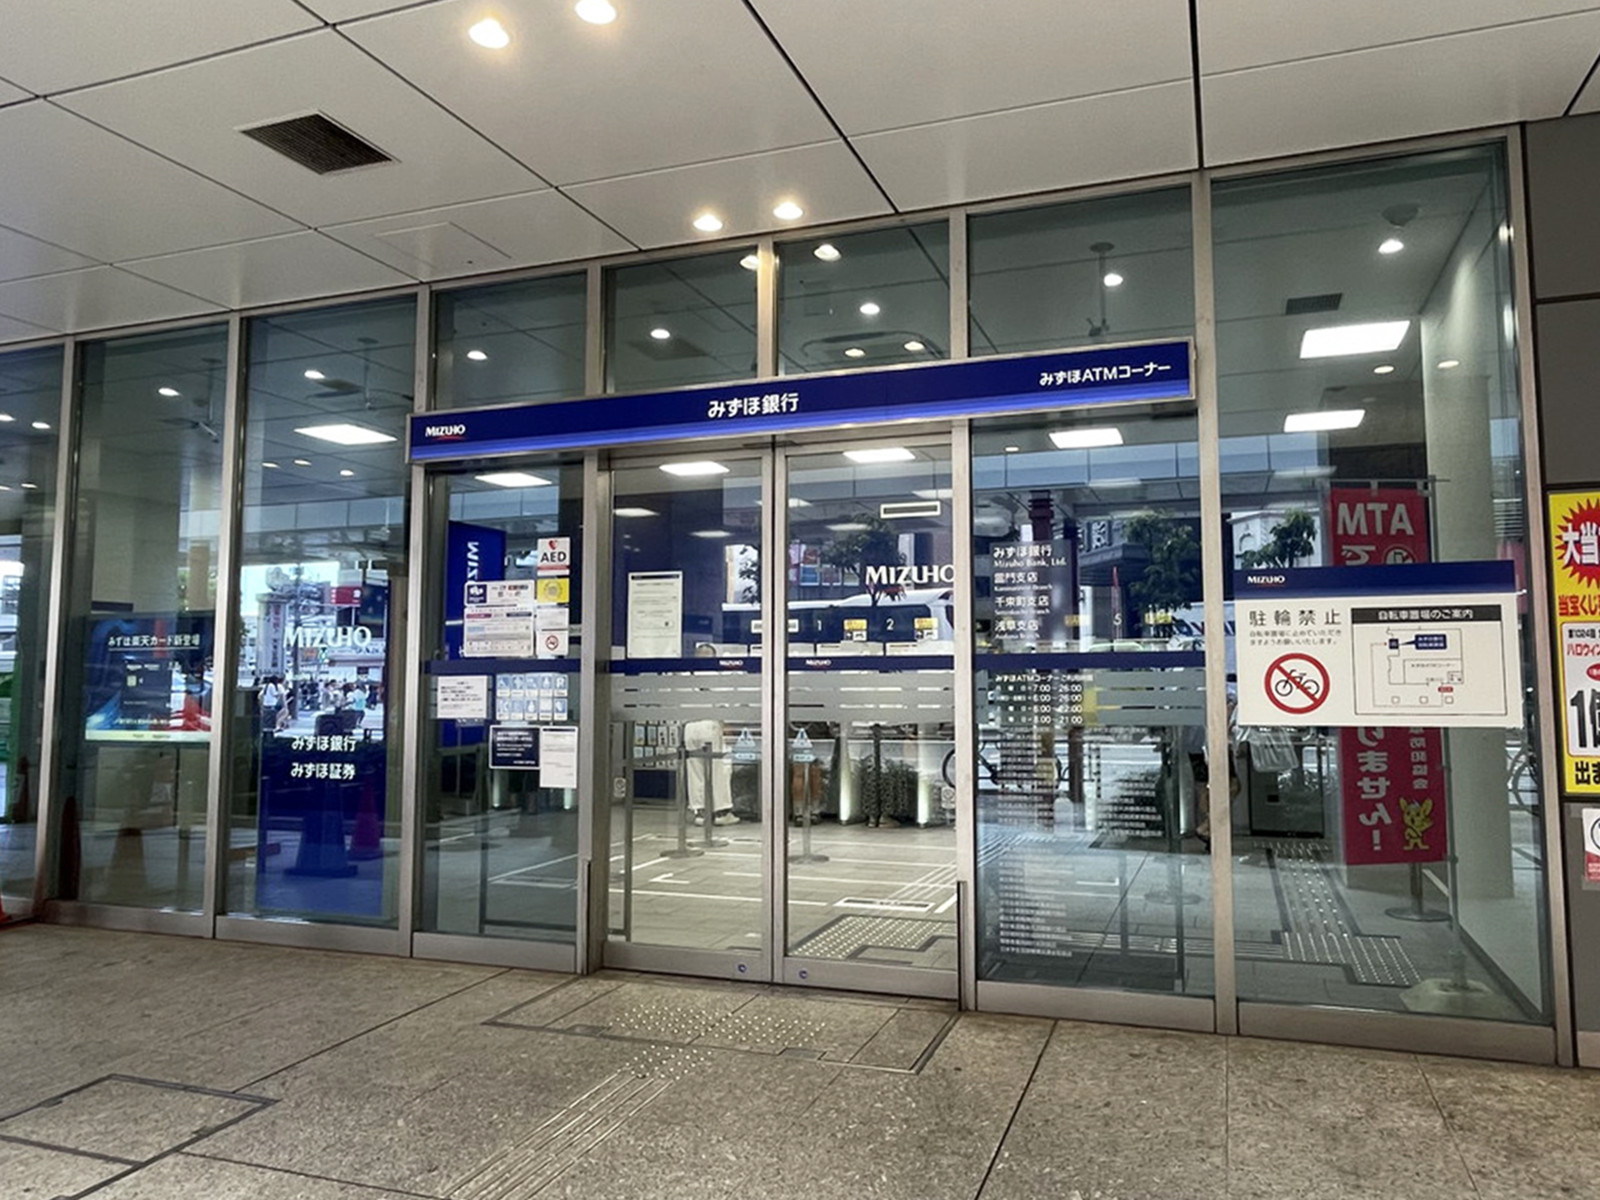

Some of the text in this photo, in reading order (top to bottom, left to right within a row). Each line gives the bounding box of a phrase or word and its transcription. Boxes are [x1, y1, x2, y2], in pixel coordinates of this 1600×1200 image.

[1039, 361, 1172, 386] みずほATMコーナー
[707, 392, 799, 419] みずほ銀行
[425, 423, 466, 438] MIZUHO
[993, 545, 1052, 558] みずほ銀行
[1563, 521, 1600, 565] 大当
[540, 551, 567, 563] AED
[1247, 575, 1286, 584] MIZUHO
[1249, 608, 1342, 627] 駐輪禁止
[284, 626, 372, 649] MIZUHO
[292, 735, 357, 752] みずほ銀行
[291, 763, 355, 780] みずほ証券
